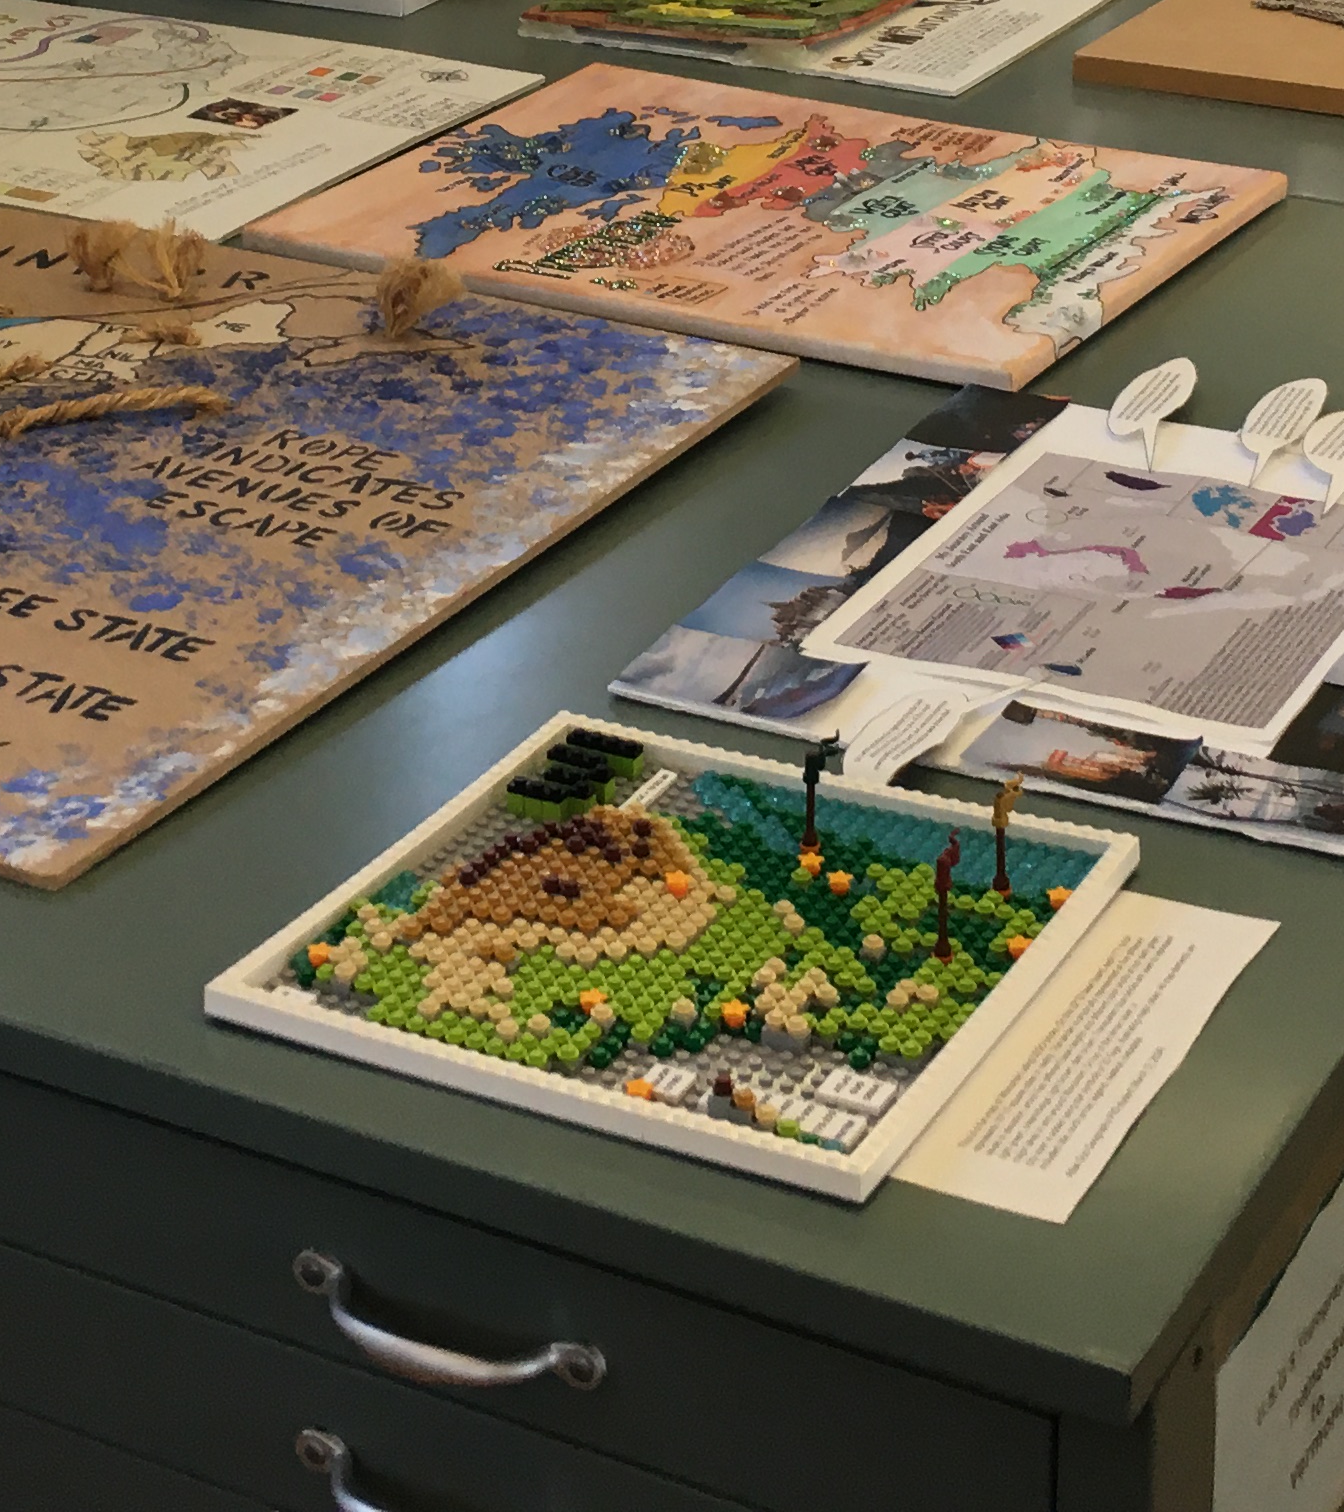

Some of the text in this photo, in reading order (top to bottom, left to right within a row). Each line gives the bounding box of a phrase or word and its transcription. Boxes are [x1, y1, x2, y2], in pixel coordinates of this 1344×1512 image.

[214, 318, 253, 333] ME
[199, 441, 466, 511] INDICATES
[261, 428, 400, 472] ROPE
[129, 455, 453, 539] AVENUES OF
[144, 490, 338, 548] ESCAPE
[53, 608, 217, 663] STATE
